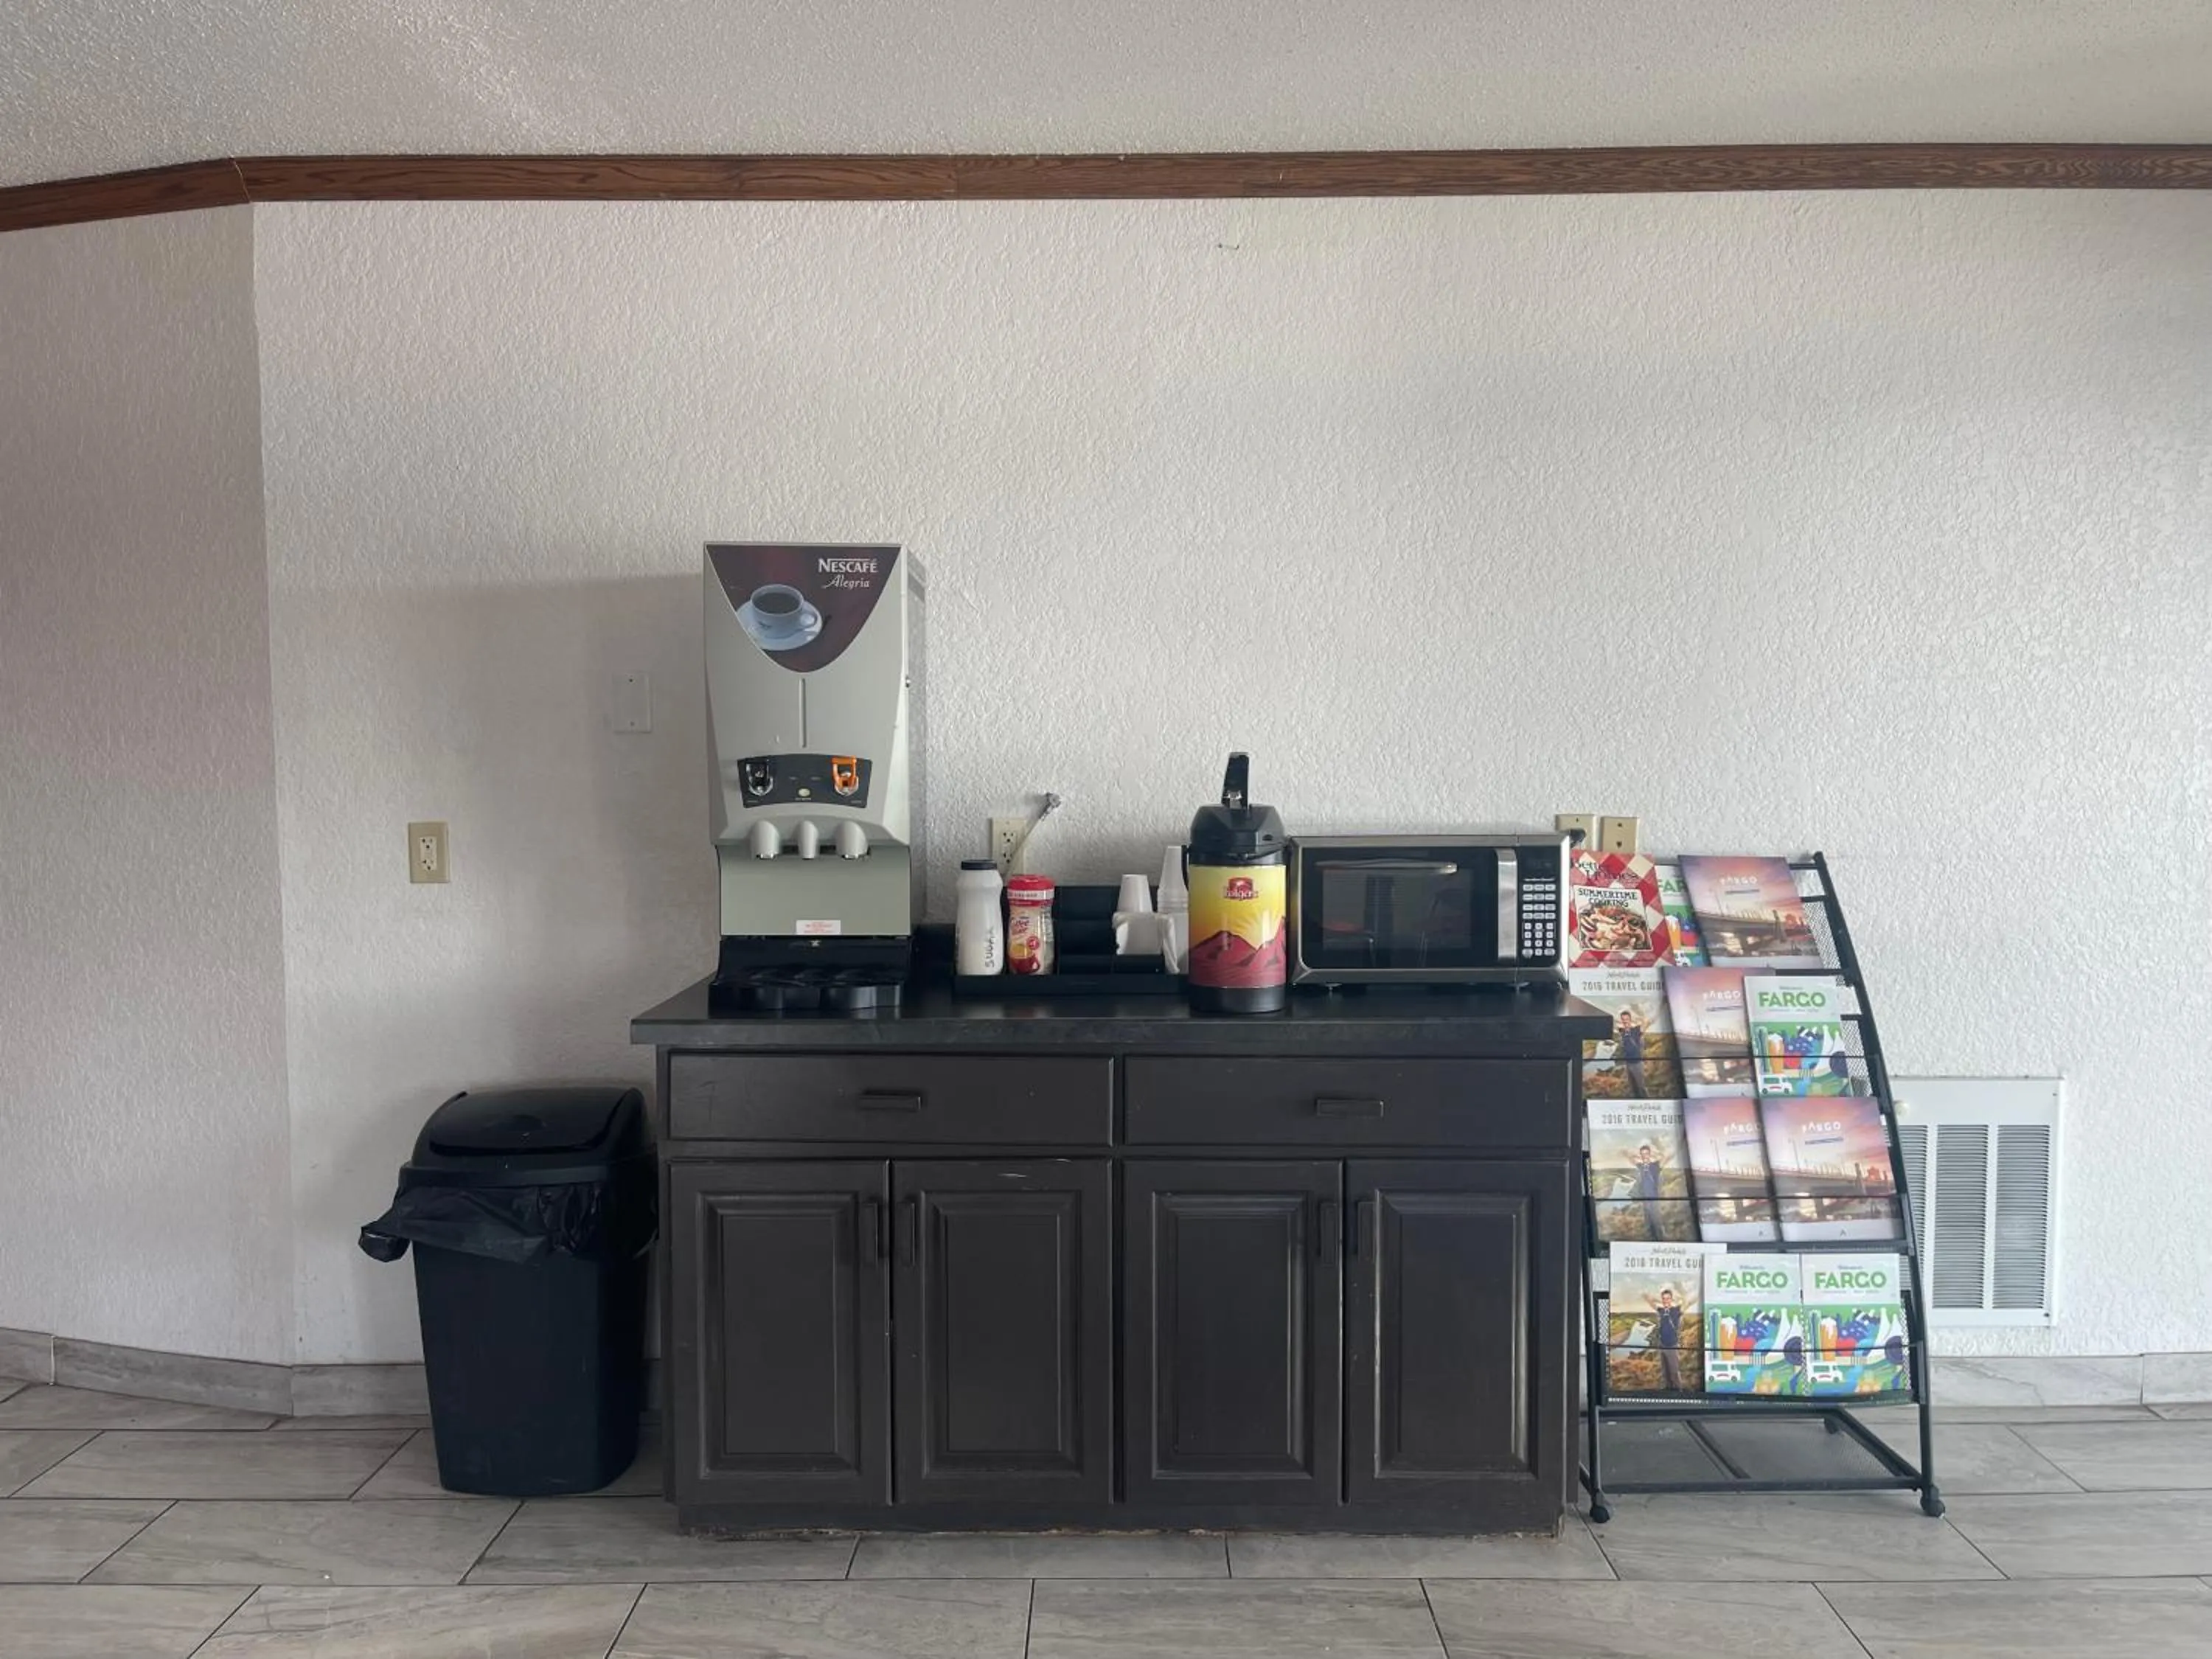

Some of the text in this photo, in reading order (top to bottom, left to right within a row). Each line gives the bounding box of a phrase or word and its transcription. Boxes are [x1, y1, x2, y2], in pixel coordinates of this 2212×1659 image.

[818, 558, 878, 573] NESCAFÉ
[821, 574, 870, 590] Alegria
[1578, 887, 1638, 900] SUMMERTIME
[1589, 897, 1629, 908] COOKING
[1606, 981, 1637, 992] TRAVEL
[1758, 992, 1826, 1007] FARGO
[1626, 1114, 1658, 1124] TRAVEL
[1649, 1257, 1682, 1269] TRAVEL
[1717, 1271, 1788, 1289] FARGO
[1815, 1271, 1887, 1289] FARGO
